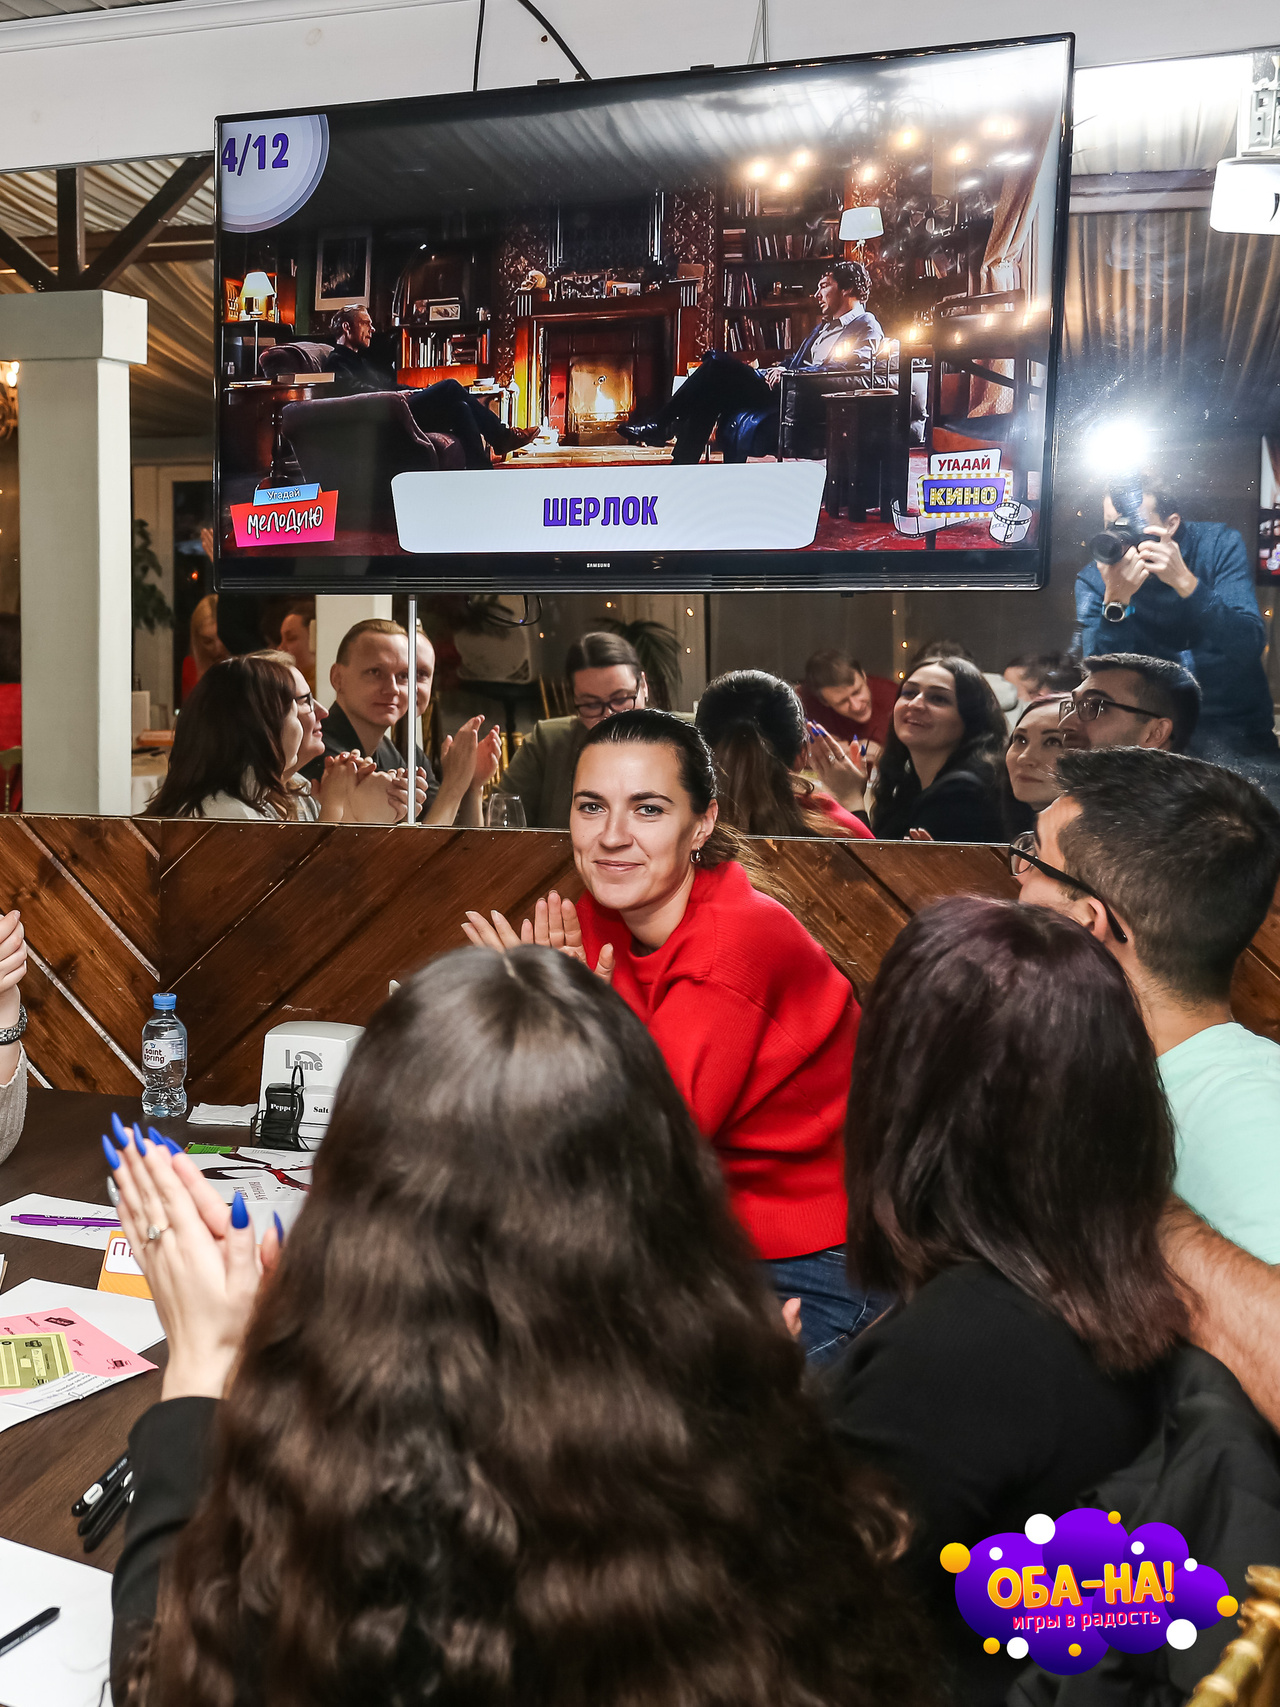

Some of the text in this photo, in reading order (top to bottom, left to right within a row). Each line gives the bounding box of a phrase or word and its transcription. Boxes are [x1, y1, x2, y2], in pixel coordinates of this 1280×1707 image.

[221, 132, 290, 177] 4/12
[937, 454, 992, 472] УГАДАЙ
[267, 487, 301, 500] Угадай
[929, 486, 998, 506] КИНО
[543, 495, 659, 527] ШЕРЛОК
[285, 1049, 324, 1071] Lime
[313, 1106, 329, 1114] Salt
